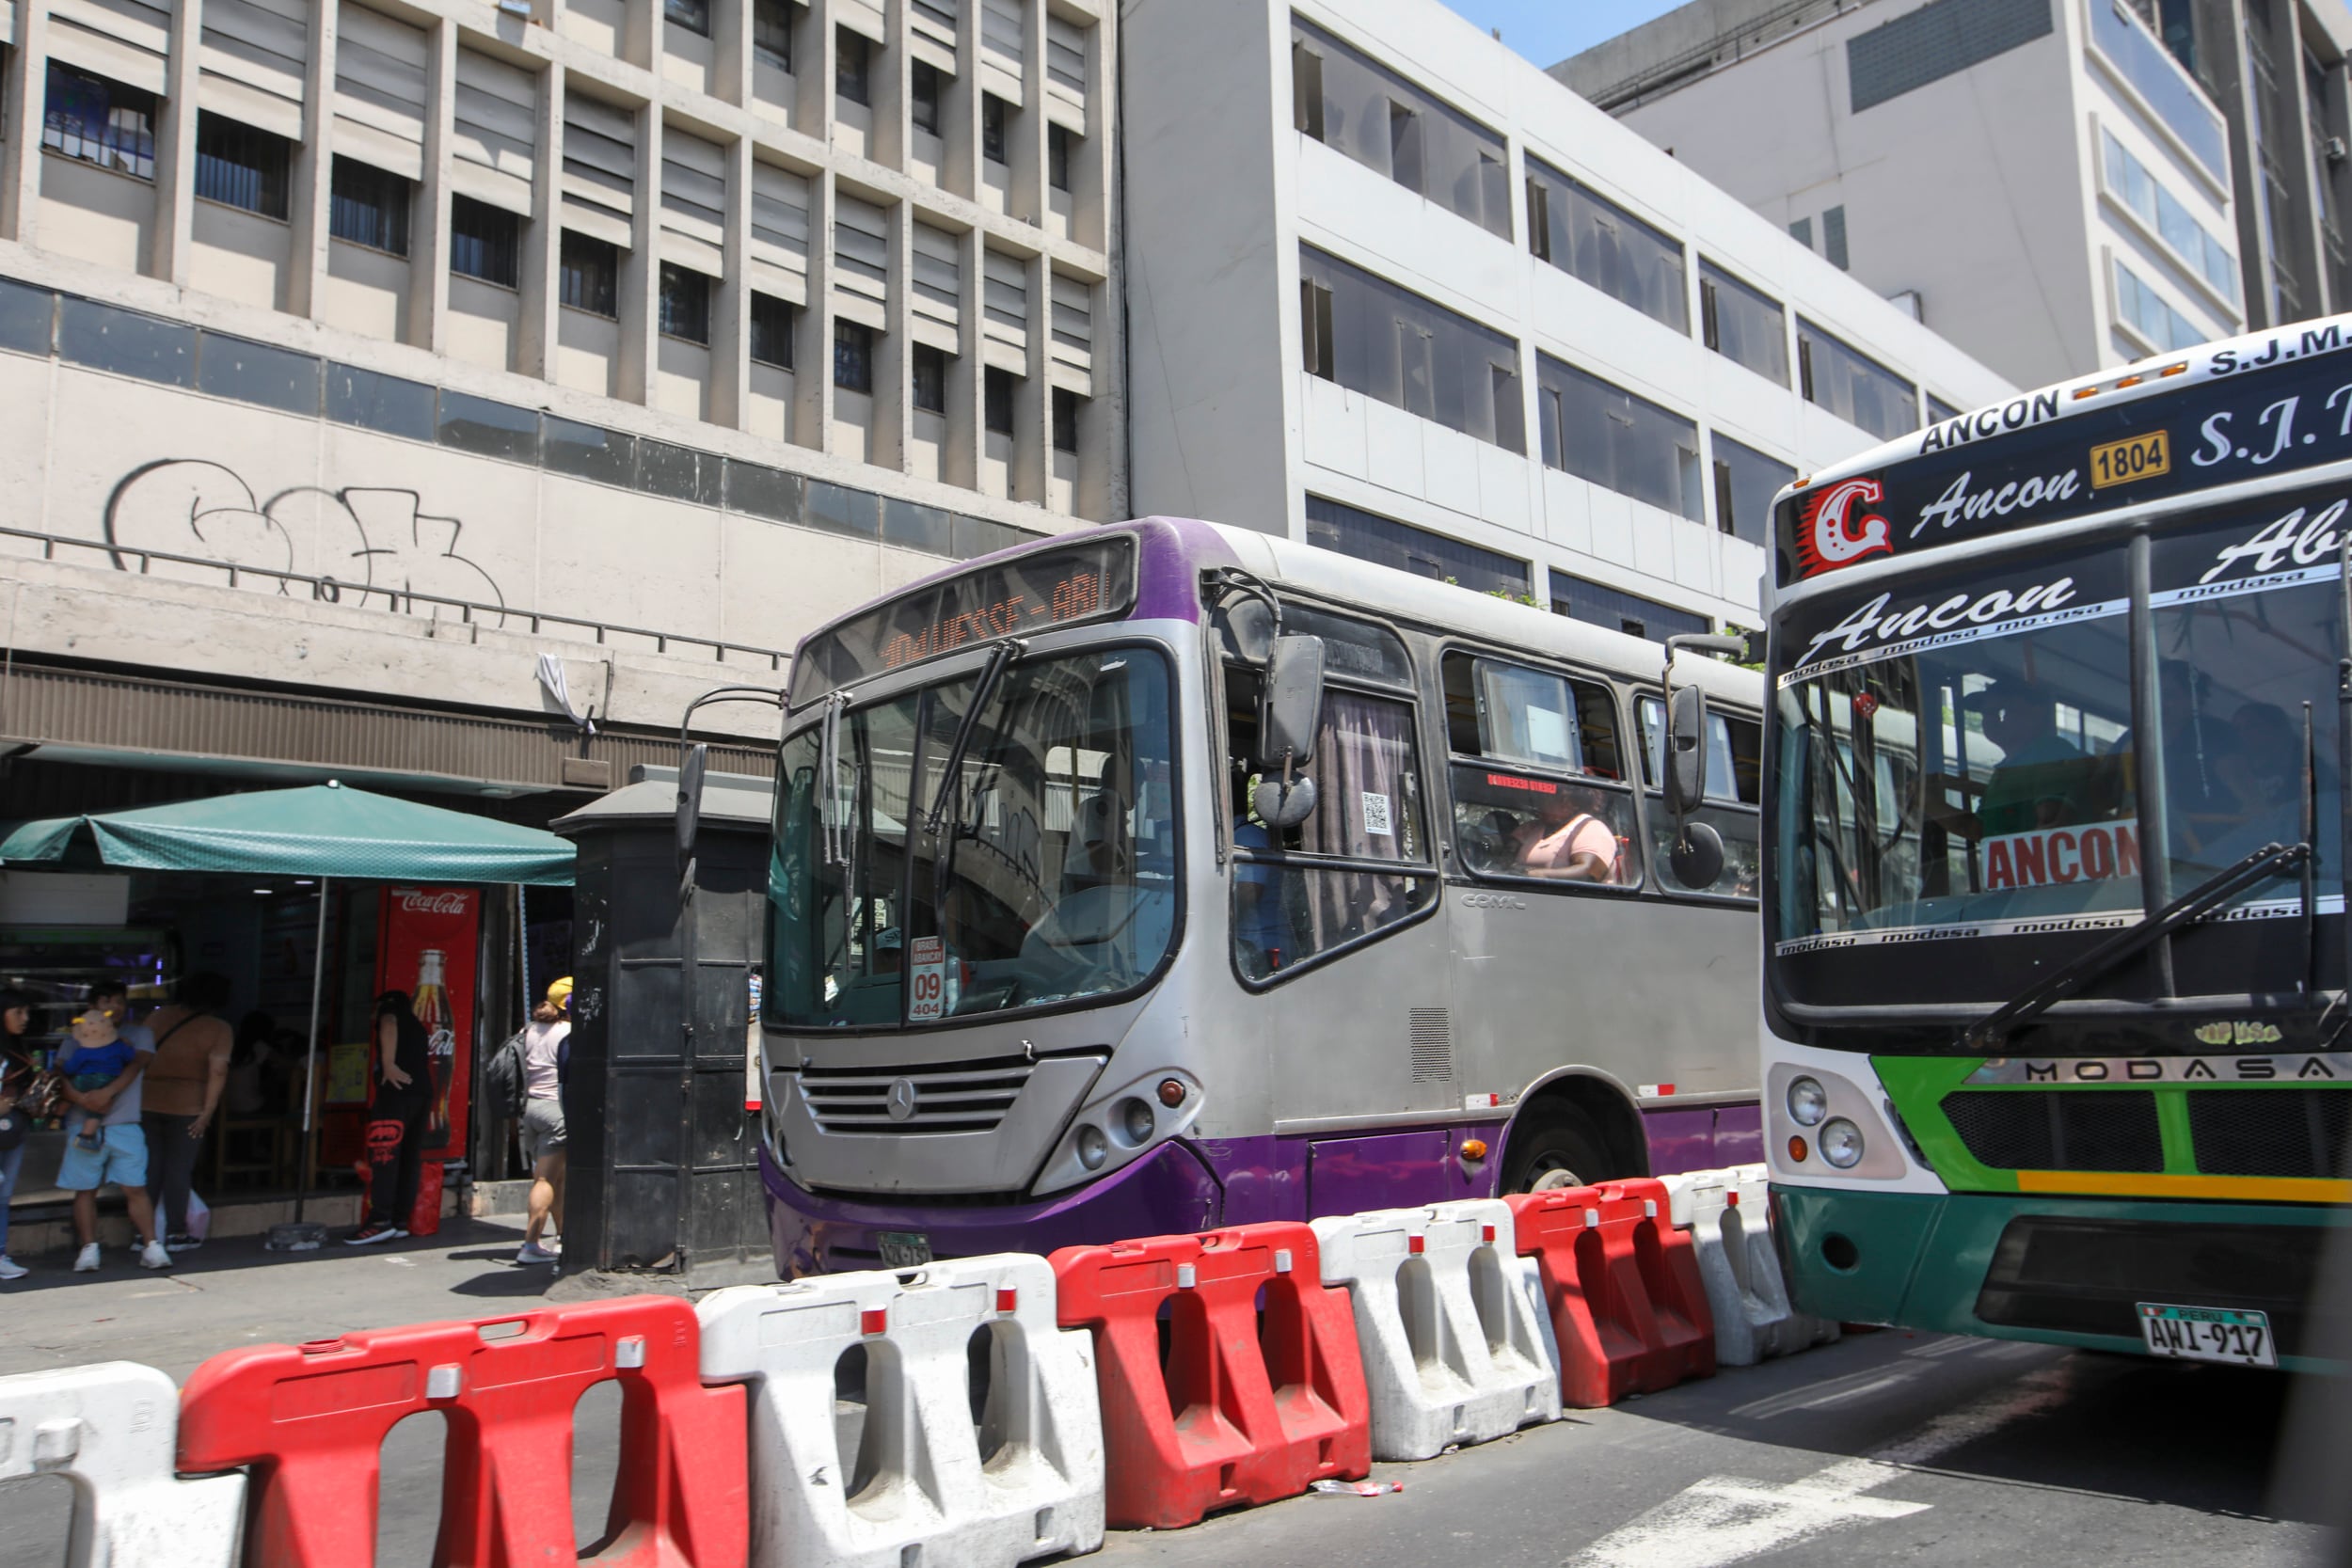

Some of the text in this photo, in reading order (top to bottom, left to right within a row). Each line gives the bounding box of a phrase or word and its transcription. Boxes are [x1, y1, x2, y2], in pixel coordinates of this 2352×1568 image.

[1919, 388, 2059, 454] ANCON
[2097, 438, 2163, 481] 1804
[1910, 468, 2080, 539] Ancon
[2177, 572, 2306, 599] modasa
[1794, 578, 2076, 669] Ancon
[1783, 656, 1859, 683] modasa
[1883, 628, 1979, 655] modasa
[1987, 825, 2142, 888] ANCON
[402, 892, 469, 914] Coca-Cola
[1781, 917, 2124, 956] modasa modasa modasa
[914, 973, 941, 1001] 09
[913, 1003, 941, 1015] 404
[2026, 1056, 2334, 1082] MODASA
[2178, 1309, 2223, 1323] PERU
[2150, 1318, 2263, 1356] AWI-917
